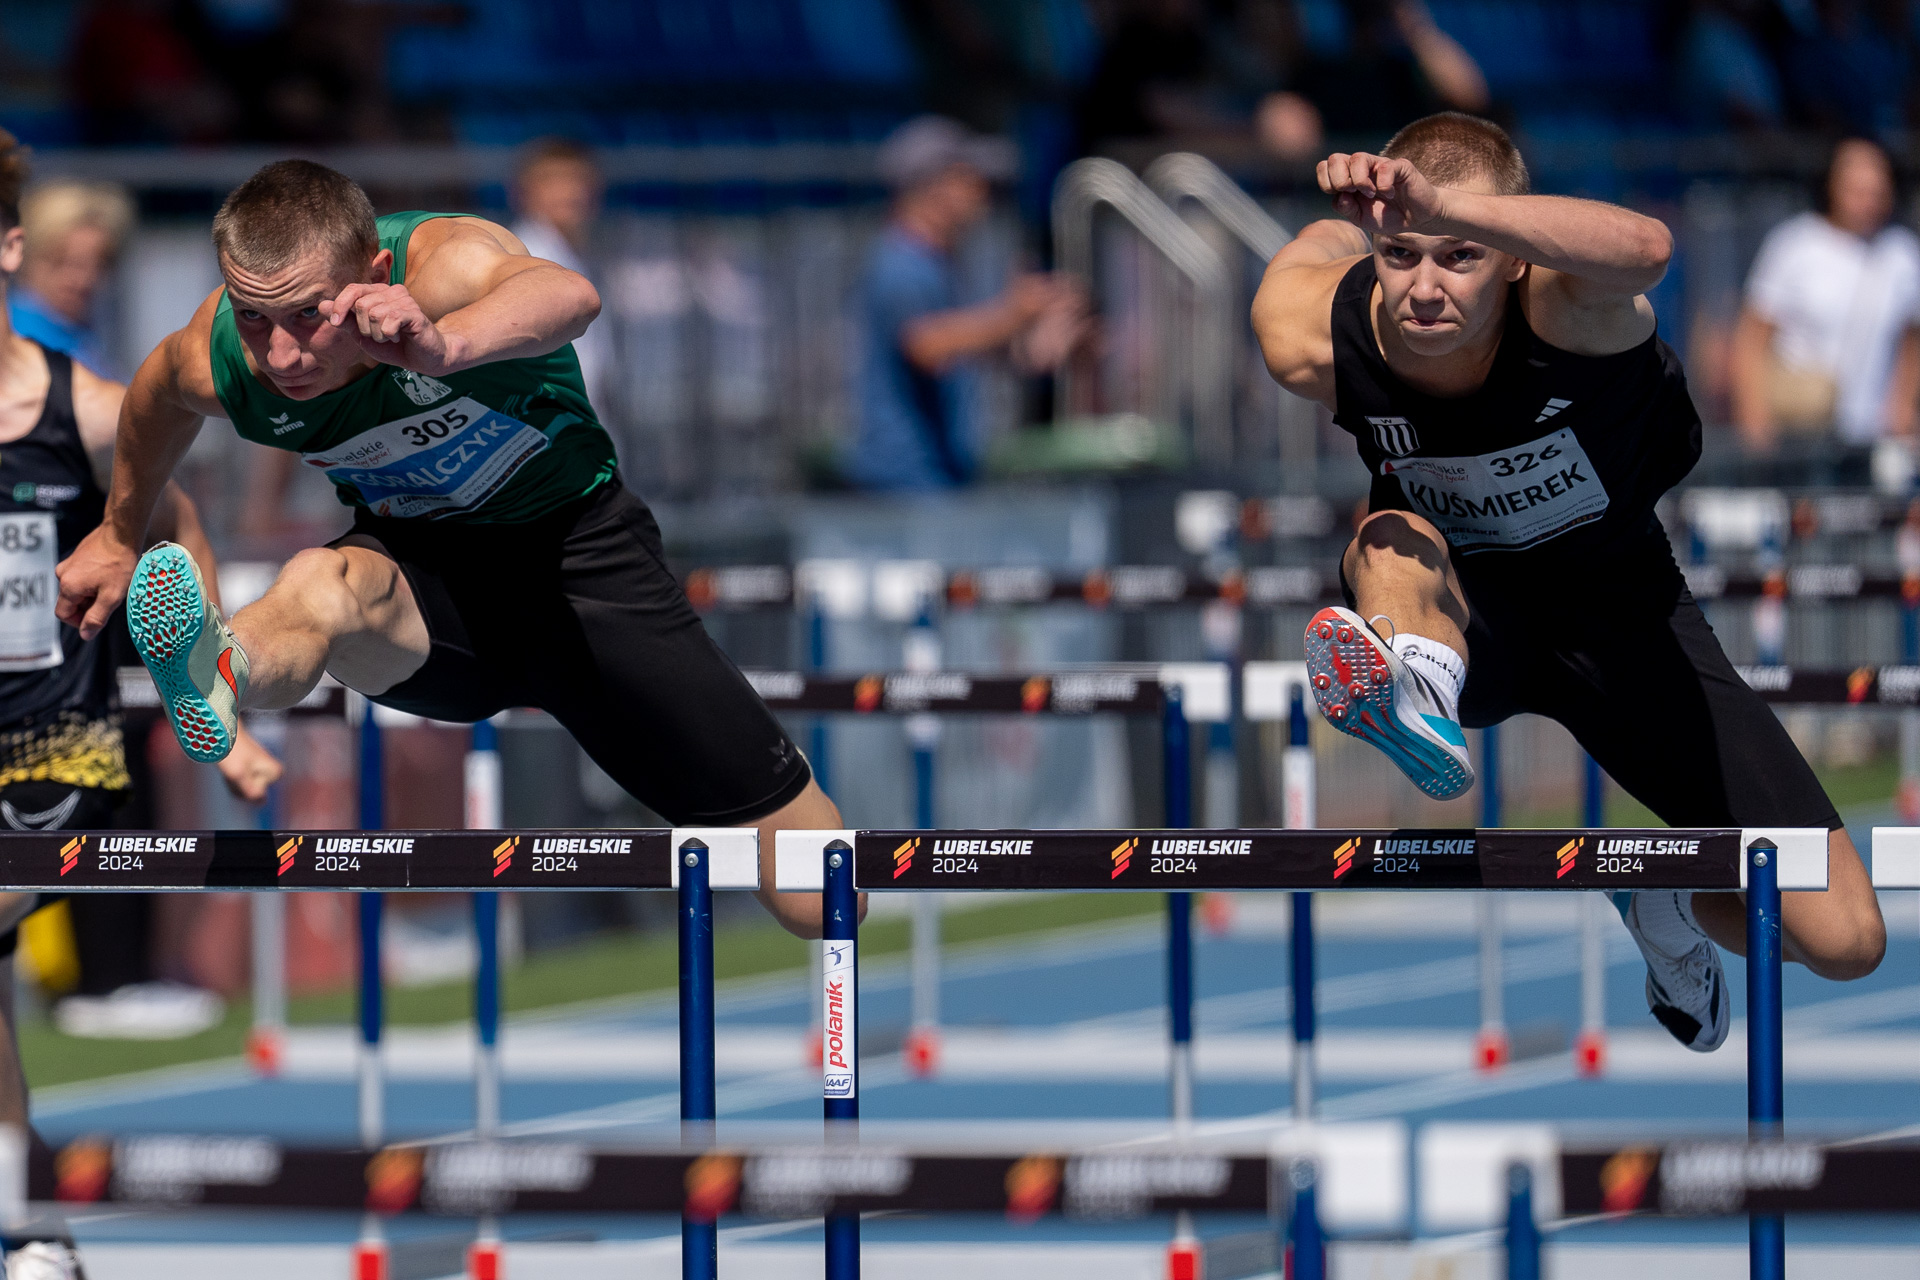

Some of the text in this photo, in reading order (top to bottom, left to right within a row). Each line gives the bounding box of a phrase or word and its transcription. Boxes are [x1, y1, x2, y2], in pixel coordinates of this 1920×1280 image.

[273, 420, 305, 436] erima
[401, 407, 469, 447] 305
[1489, 443, 1563, 477] 326
[1408, 461, 1588, 519] KUŚMIEREK
[401, 501, 430, 516] 2024
[0, 524, 42, 552] 85
[1442, 526, 1500, 536] UBELSKIE
[99, 838, 197, 852] LUBELSKIE
[315, 838, 415, 853] LUBELSKIE
[532, 838, 632, 853] LUBELSKIE
[932, 839, 1034, 855] LUBELSKIE
[1150, 839, 1253, 855] LUBELSKIE
[1373, 839, 1476, 855] LUBELSKIE
[1596, 839, 1701, 855] LUBELSKIE
[99, 856, 144, 871] 2024
[315, 857, 361, 872] 2024
[532, 857, 579, 872] 2024
[932, 858, 979, 873] 2024
[1150, 858, 1198, 873] 2024
[1373, 858, 1418, 872] 2024
[1596, 858, 1645, 873] 2024
[826, 980, 848, 1069] polanik
[826, 1078, 850, 1087] IAAF
